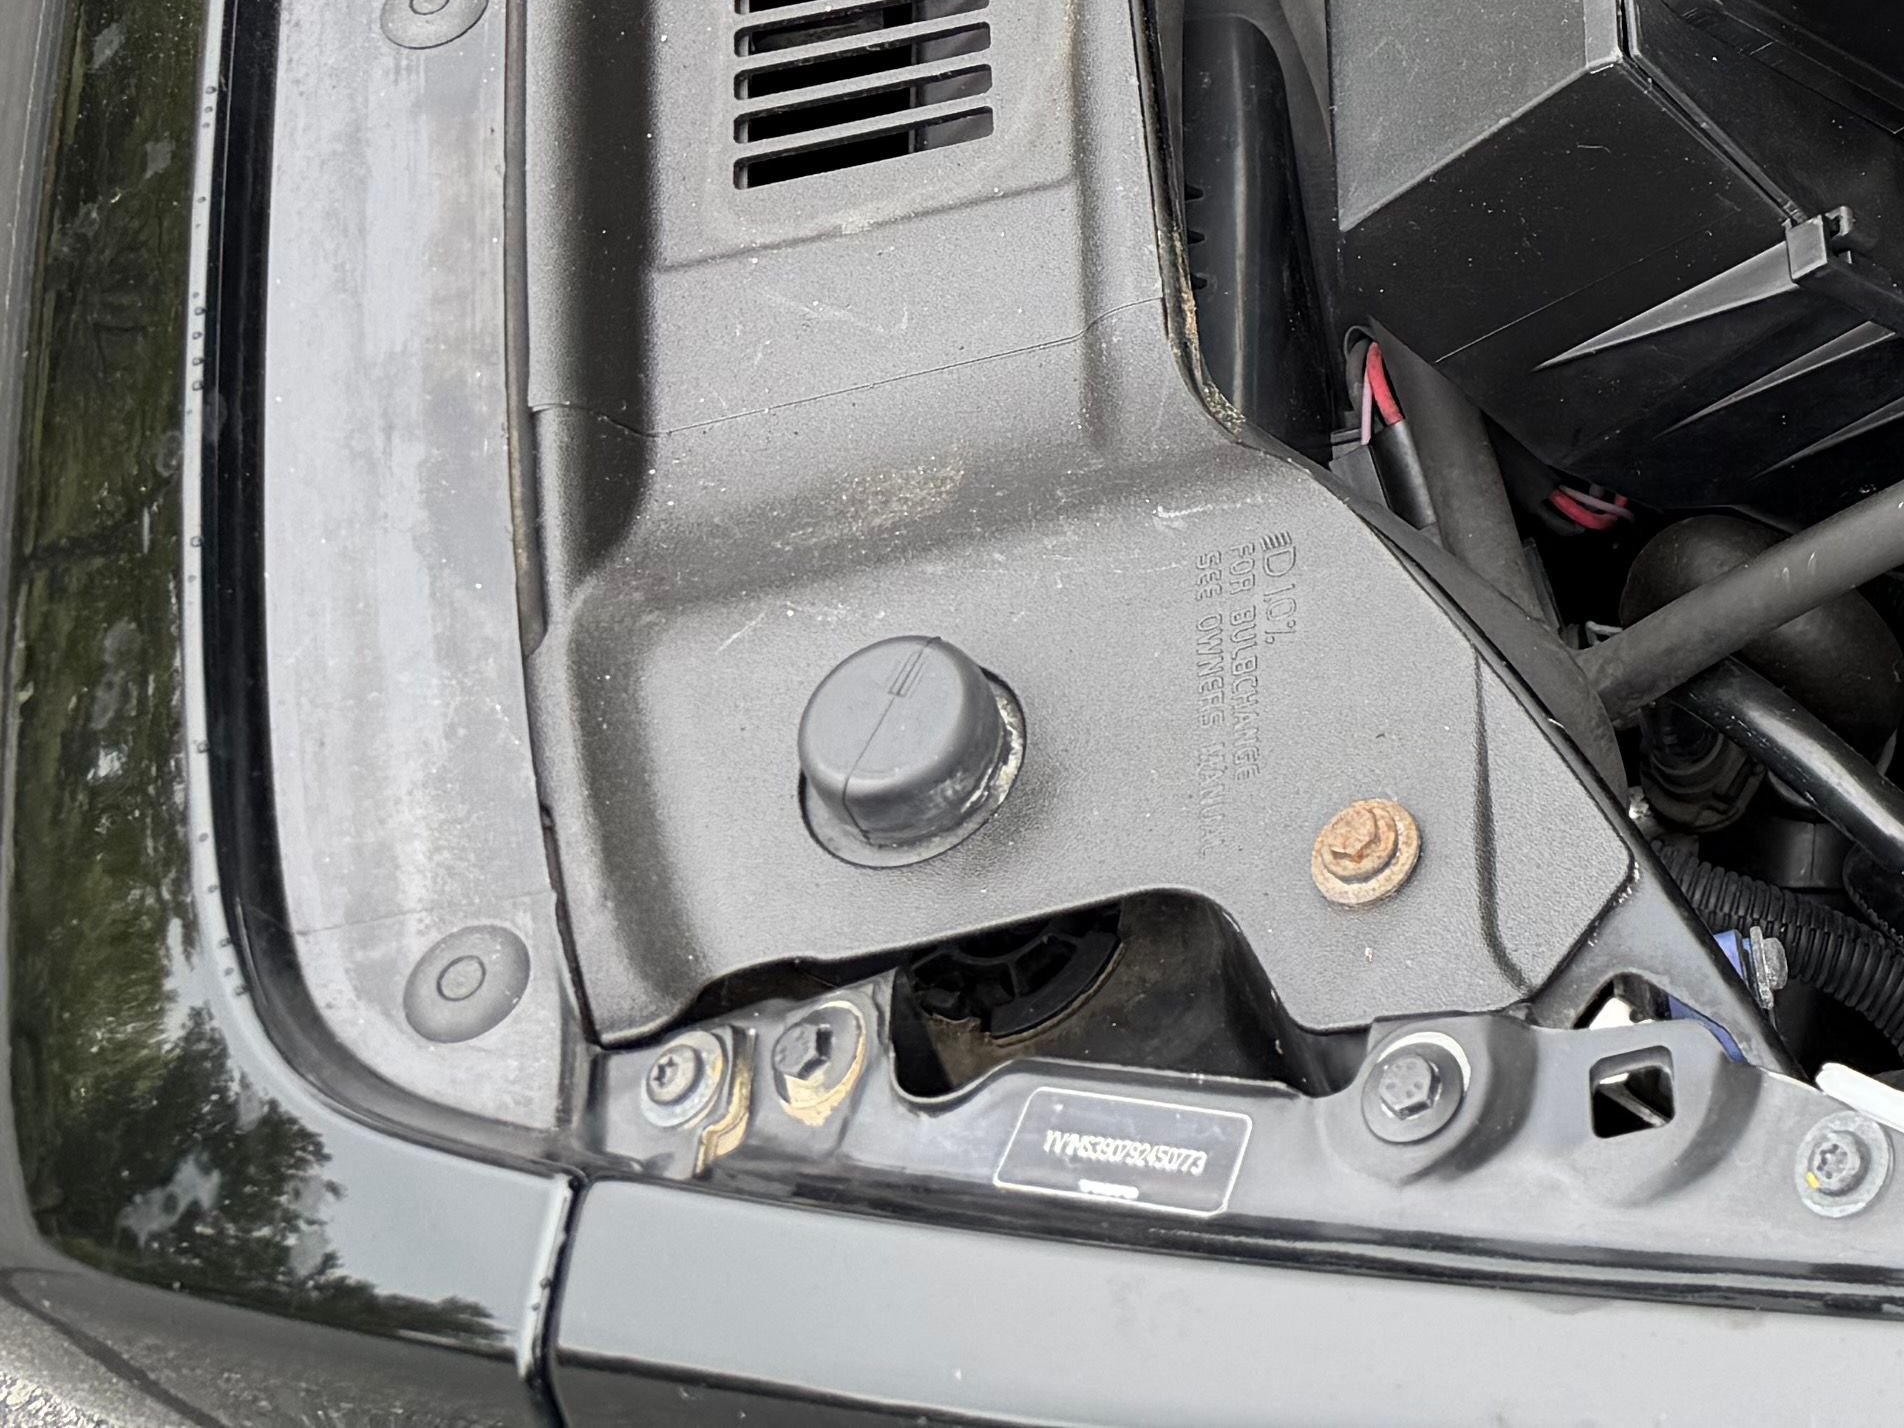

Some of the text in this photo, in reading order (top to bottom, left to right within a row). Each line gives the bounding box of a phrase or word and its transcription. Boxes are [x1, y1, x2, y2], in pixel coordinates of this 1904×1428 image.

[1194, 552, 1229, 857] SEE OWNERS MANUAL
[1228, 542, 1262, 782] FOR BULBCHANGE
